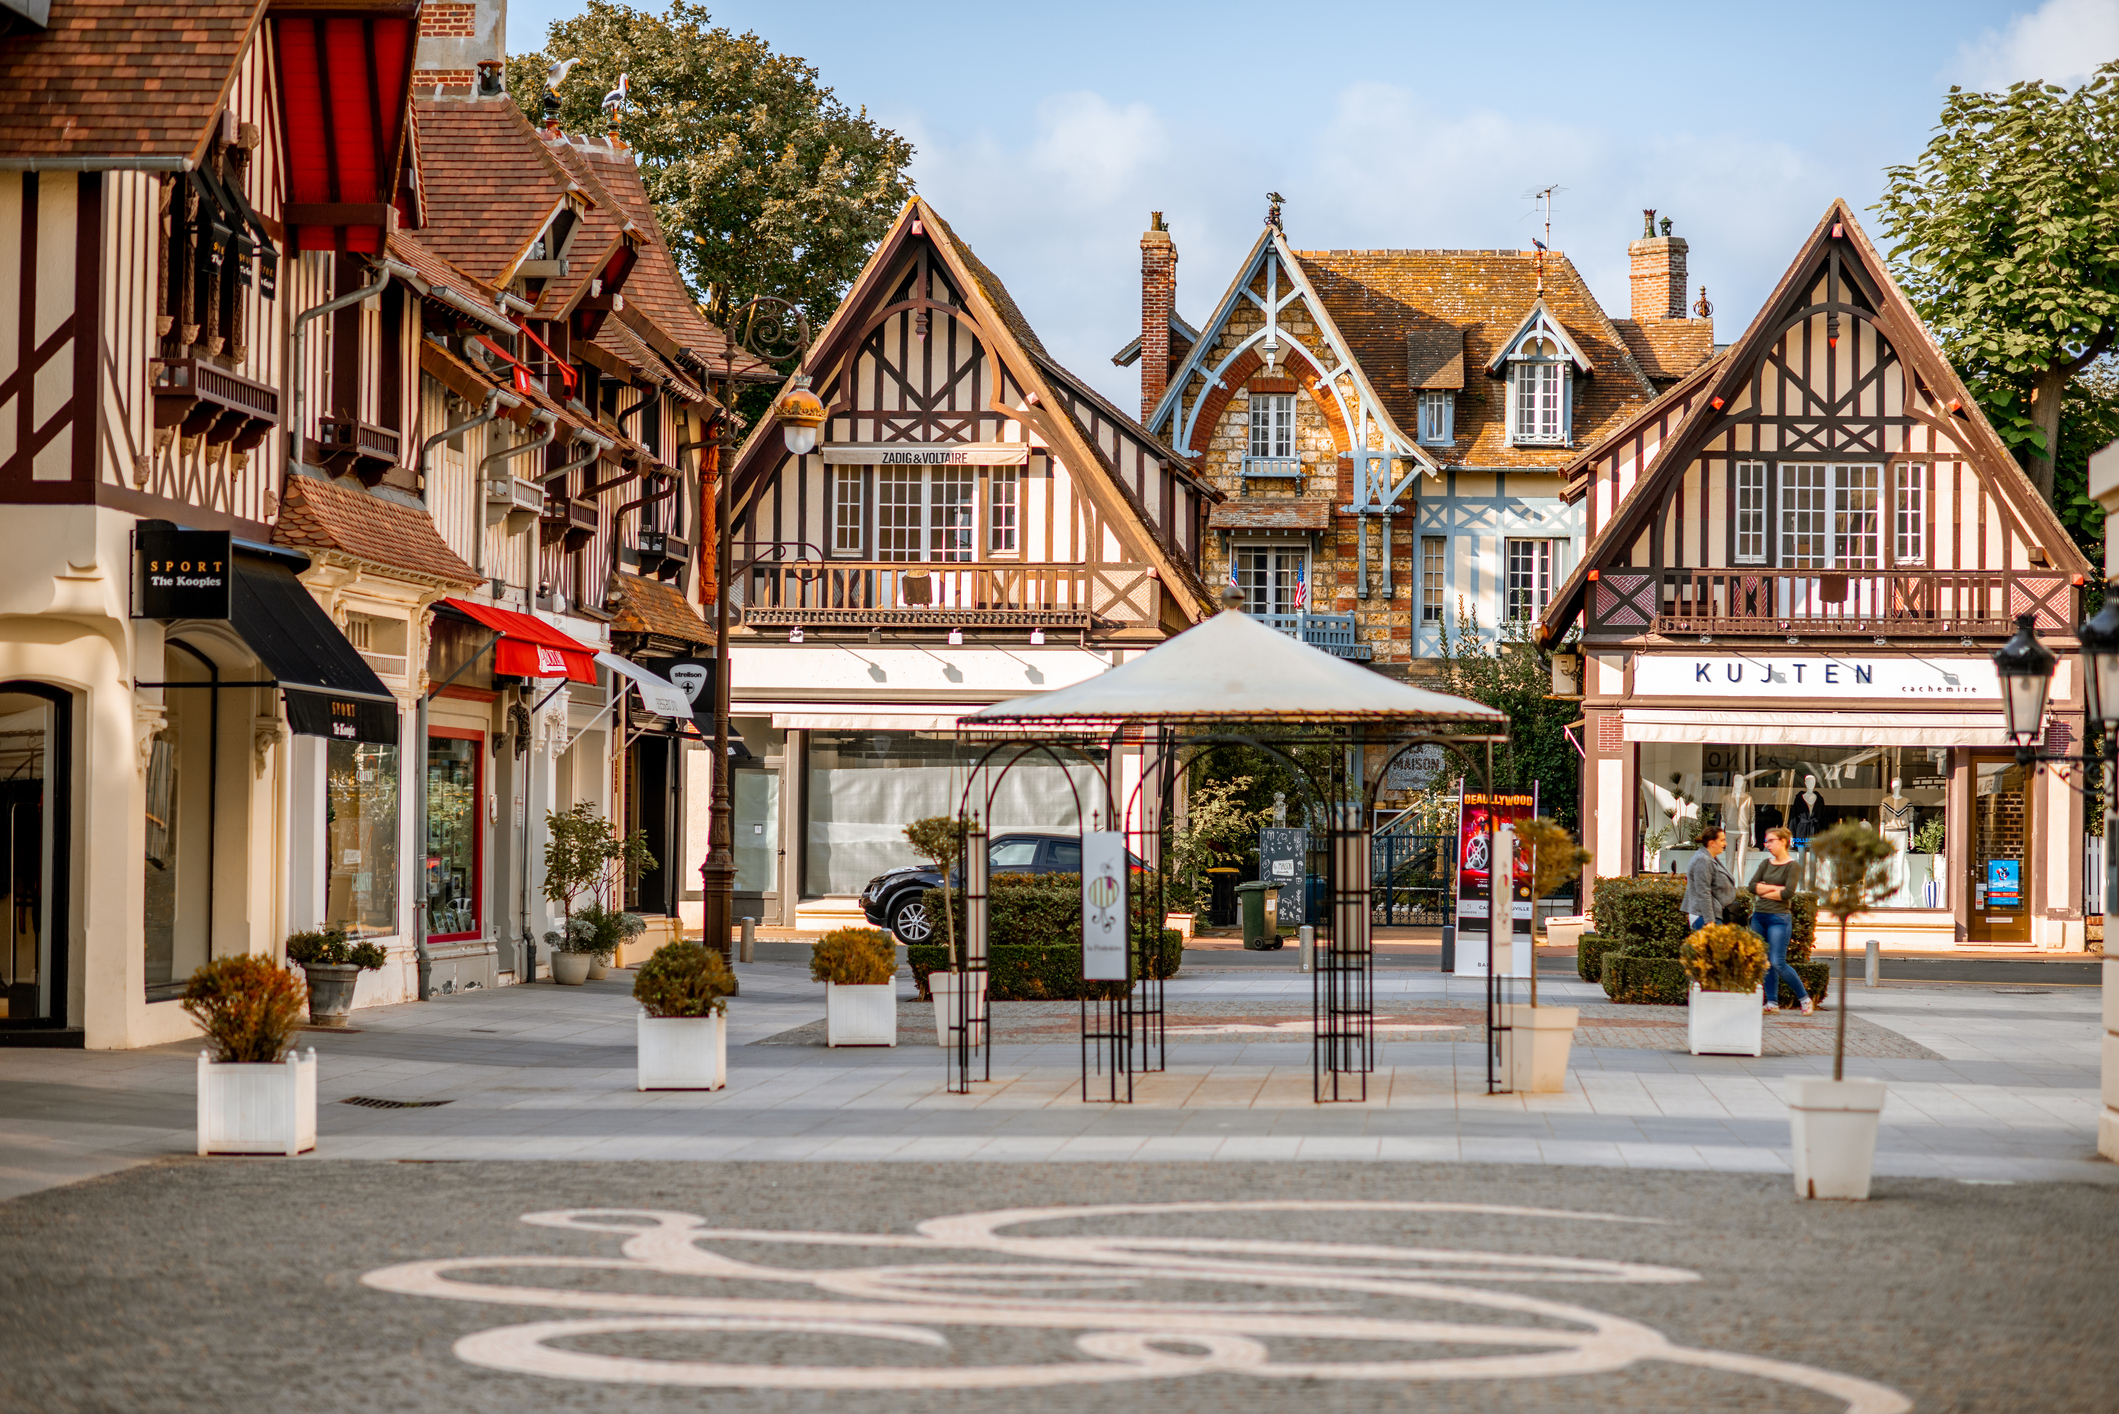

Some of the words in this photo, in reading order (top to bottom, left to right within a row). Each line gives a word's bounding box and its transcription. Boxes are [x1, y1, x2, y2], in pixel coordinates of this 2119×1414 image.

[882, 452, 968, 464] ZADIG&VOLTAIRE
[150, 561, 223, 572] SPORT
[150, 576, 174, 586] The
[176, 576, 222, 588] Kooples
[1695, 663, 1872, 684] KUJTEN
[332, 701, 356, 717] SPORT
[1393, 758, 1440, 770] MAISON
